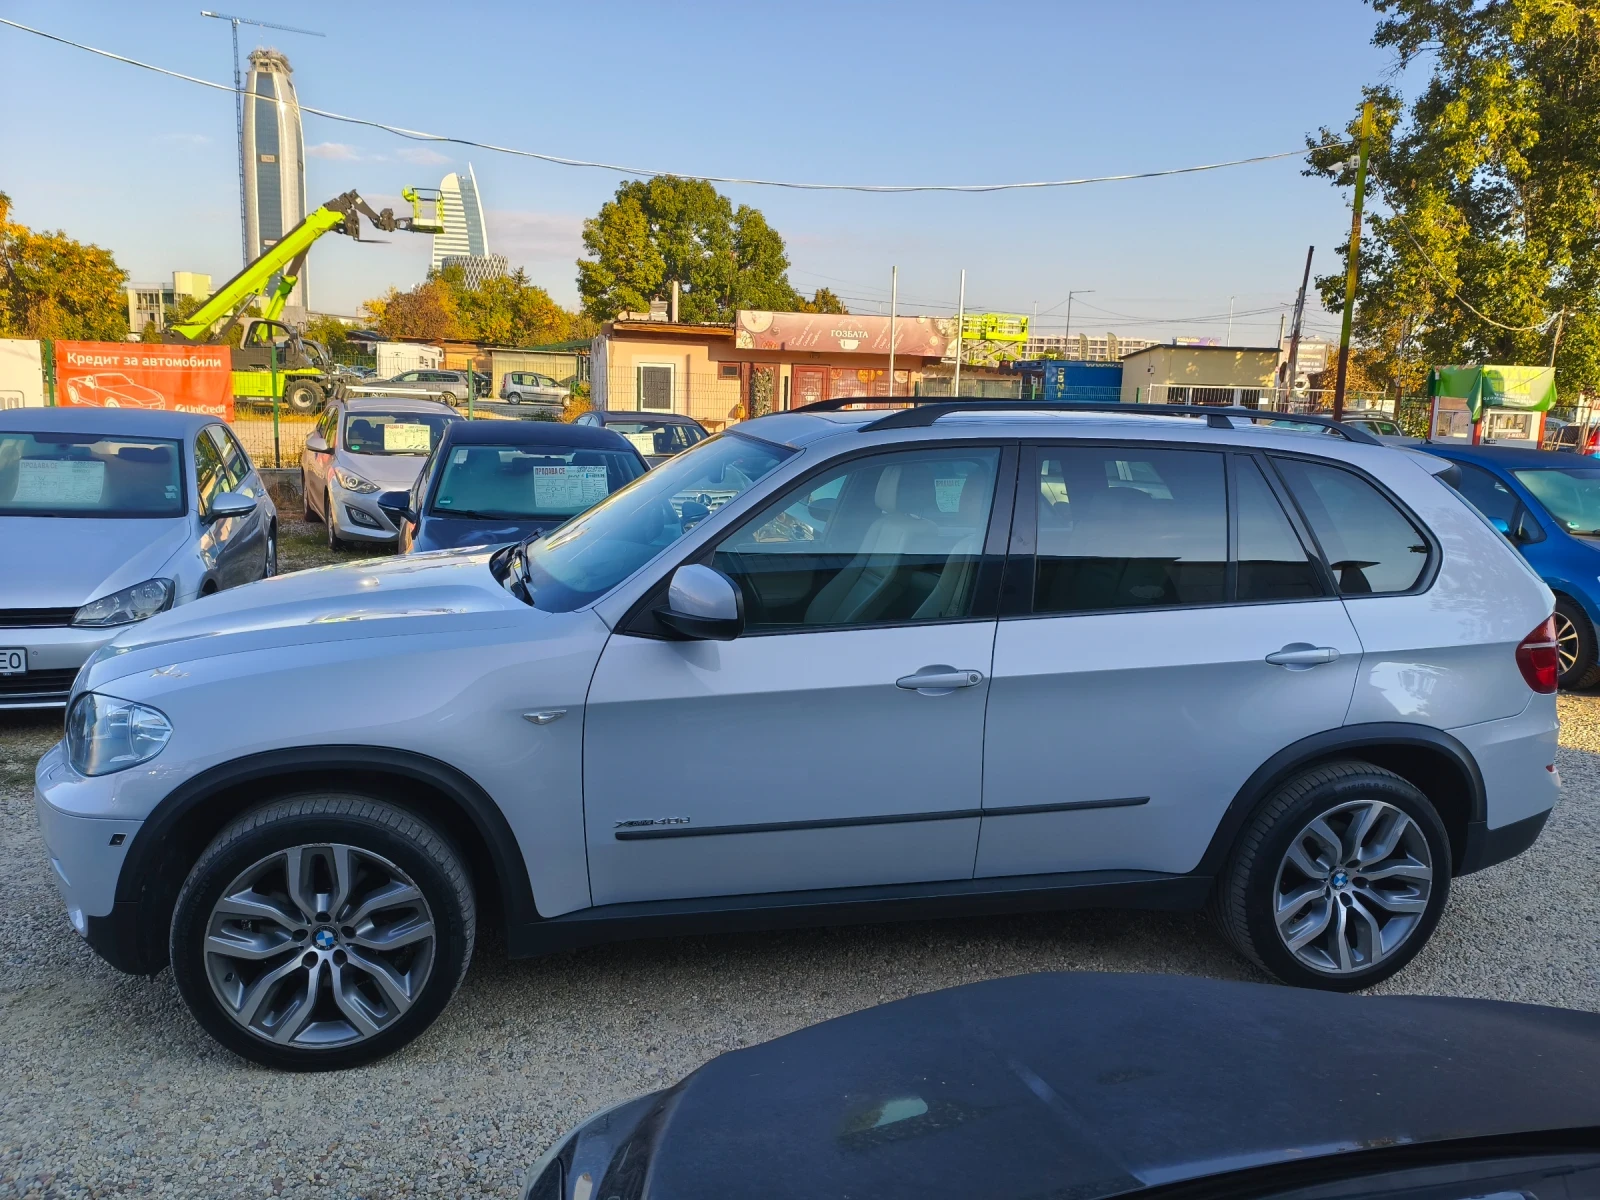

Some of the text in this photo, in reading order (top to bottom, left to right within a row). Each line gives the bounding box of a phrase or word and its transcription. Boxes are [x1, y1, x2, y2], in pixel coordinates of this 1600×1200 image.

[830, 329, 869, 339] ГОЗБАТА
[67, 352, 222, 367] Кредит за автомобили
[186, 404, 226, 414] UniCredit
[20, 461, 50, 469] ПРОДАВА
[535, 467, 566, 475] ПРОДАВА СЕ
